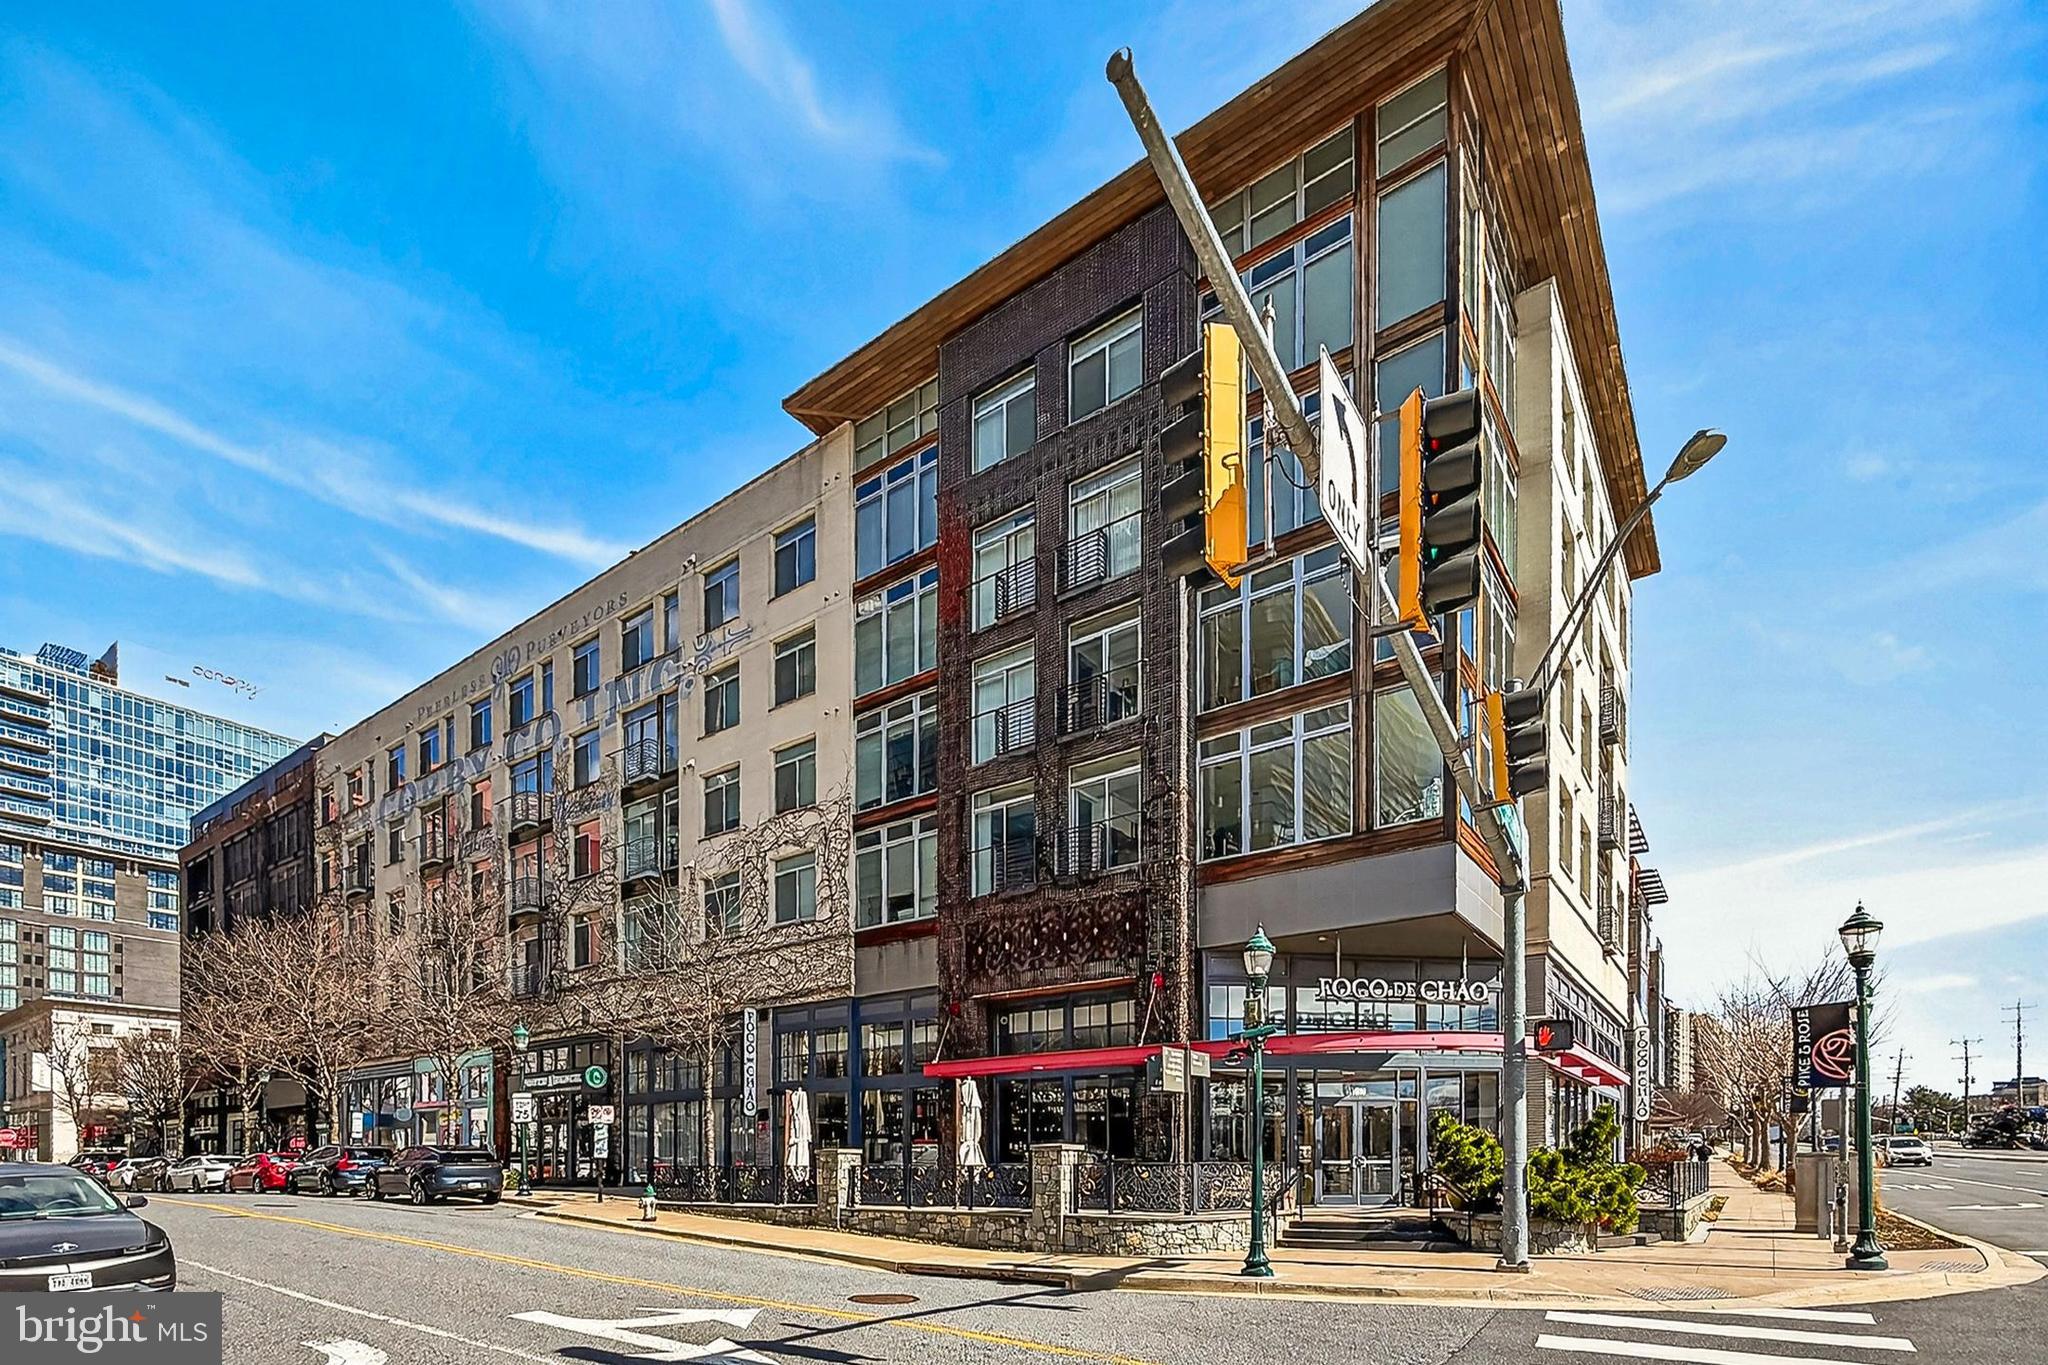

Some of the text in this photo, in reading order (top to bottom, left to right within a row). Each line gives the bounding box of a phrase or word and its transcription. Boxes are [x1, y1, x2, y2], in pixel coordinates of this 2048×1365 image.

[1328, 480, 1361, 547] ONLY
[526, 591, 628, 662] PURVEYORS
[1316, 977, 1389, 999] FOGO
[1393, 981, 1417, 998] DE
[1796, 1009, 1811, 1043] ROSE
[1797, 1057, 1811, 1087] PIKE
